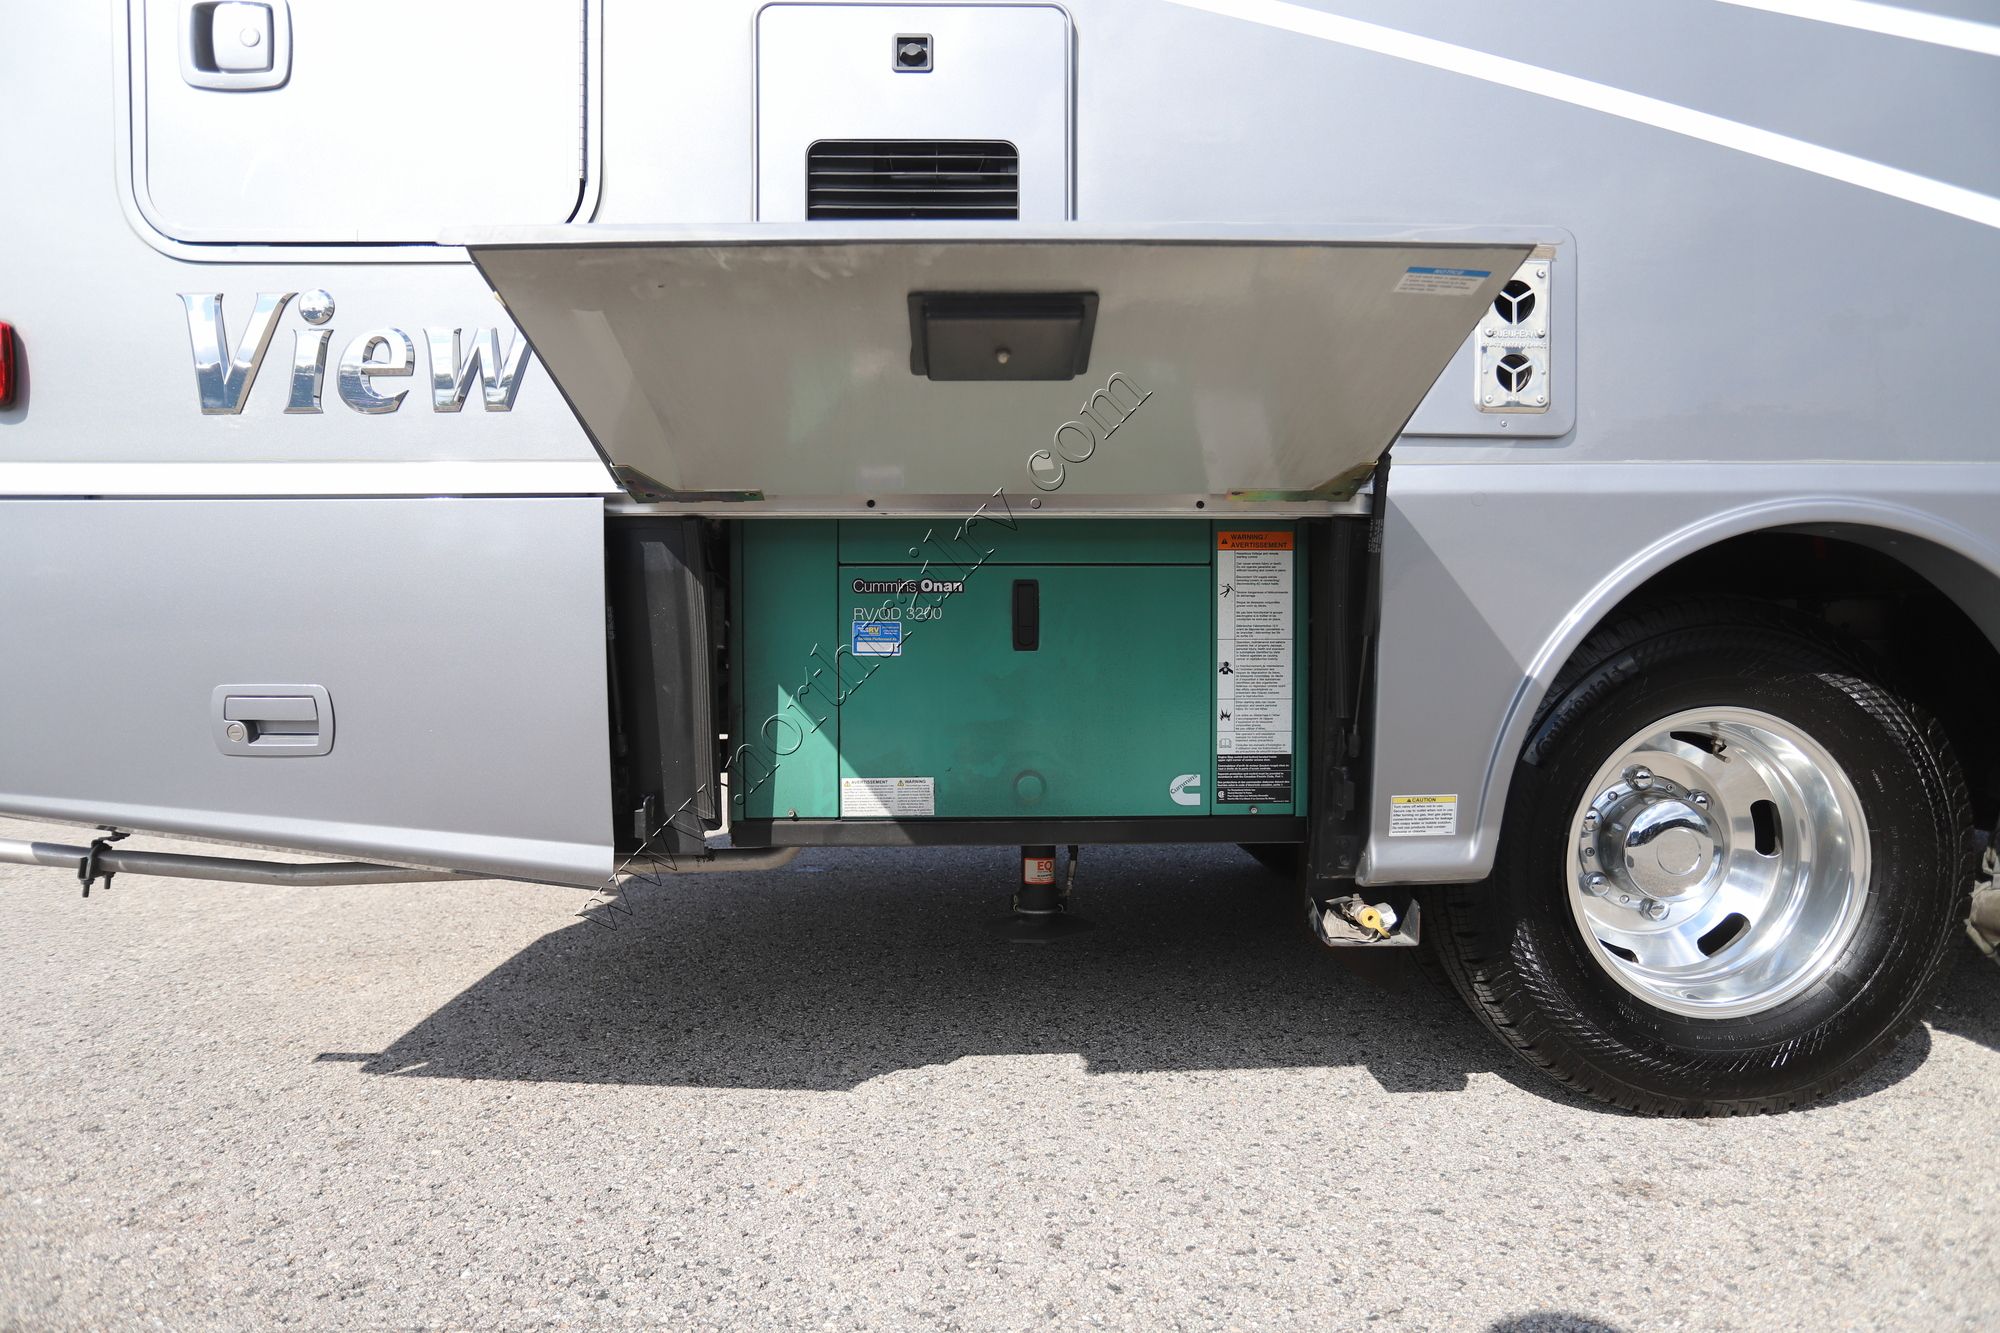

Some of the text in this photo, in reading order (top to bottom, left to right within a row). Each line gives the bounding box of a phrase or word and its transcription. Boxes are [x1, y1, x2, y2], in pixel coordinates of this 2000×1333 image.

[176, 288, 534, 415] View
[853, 579, 963, 592] Cummins Onan
[906, 607, 942, 620] 3200
